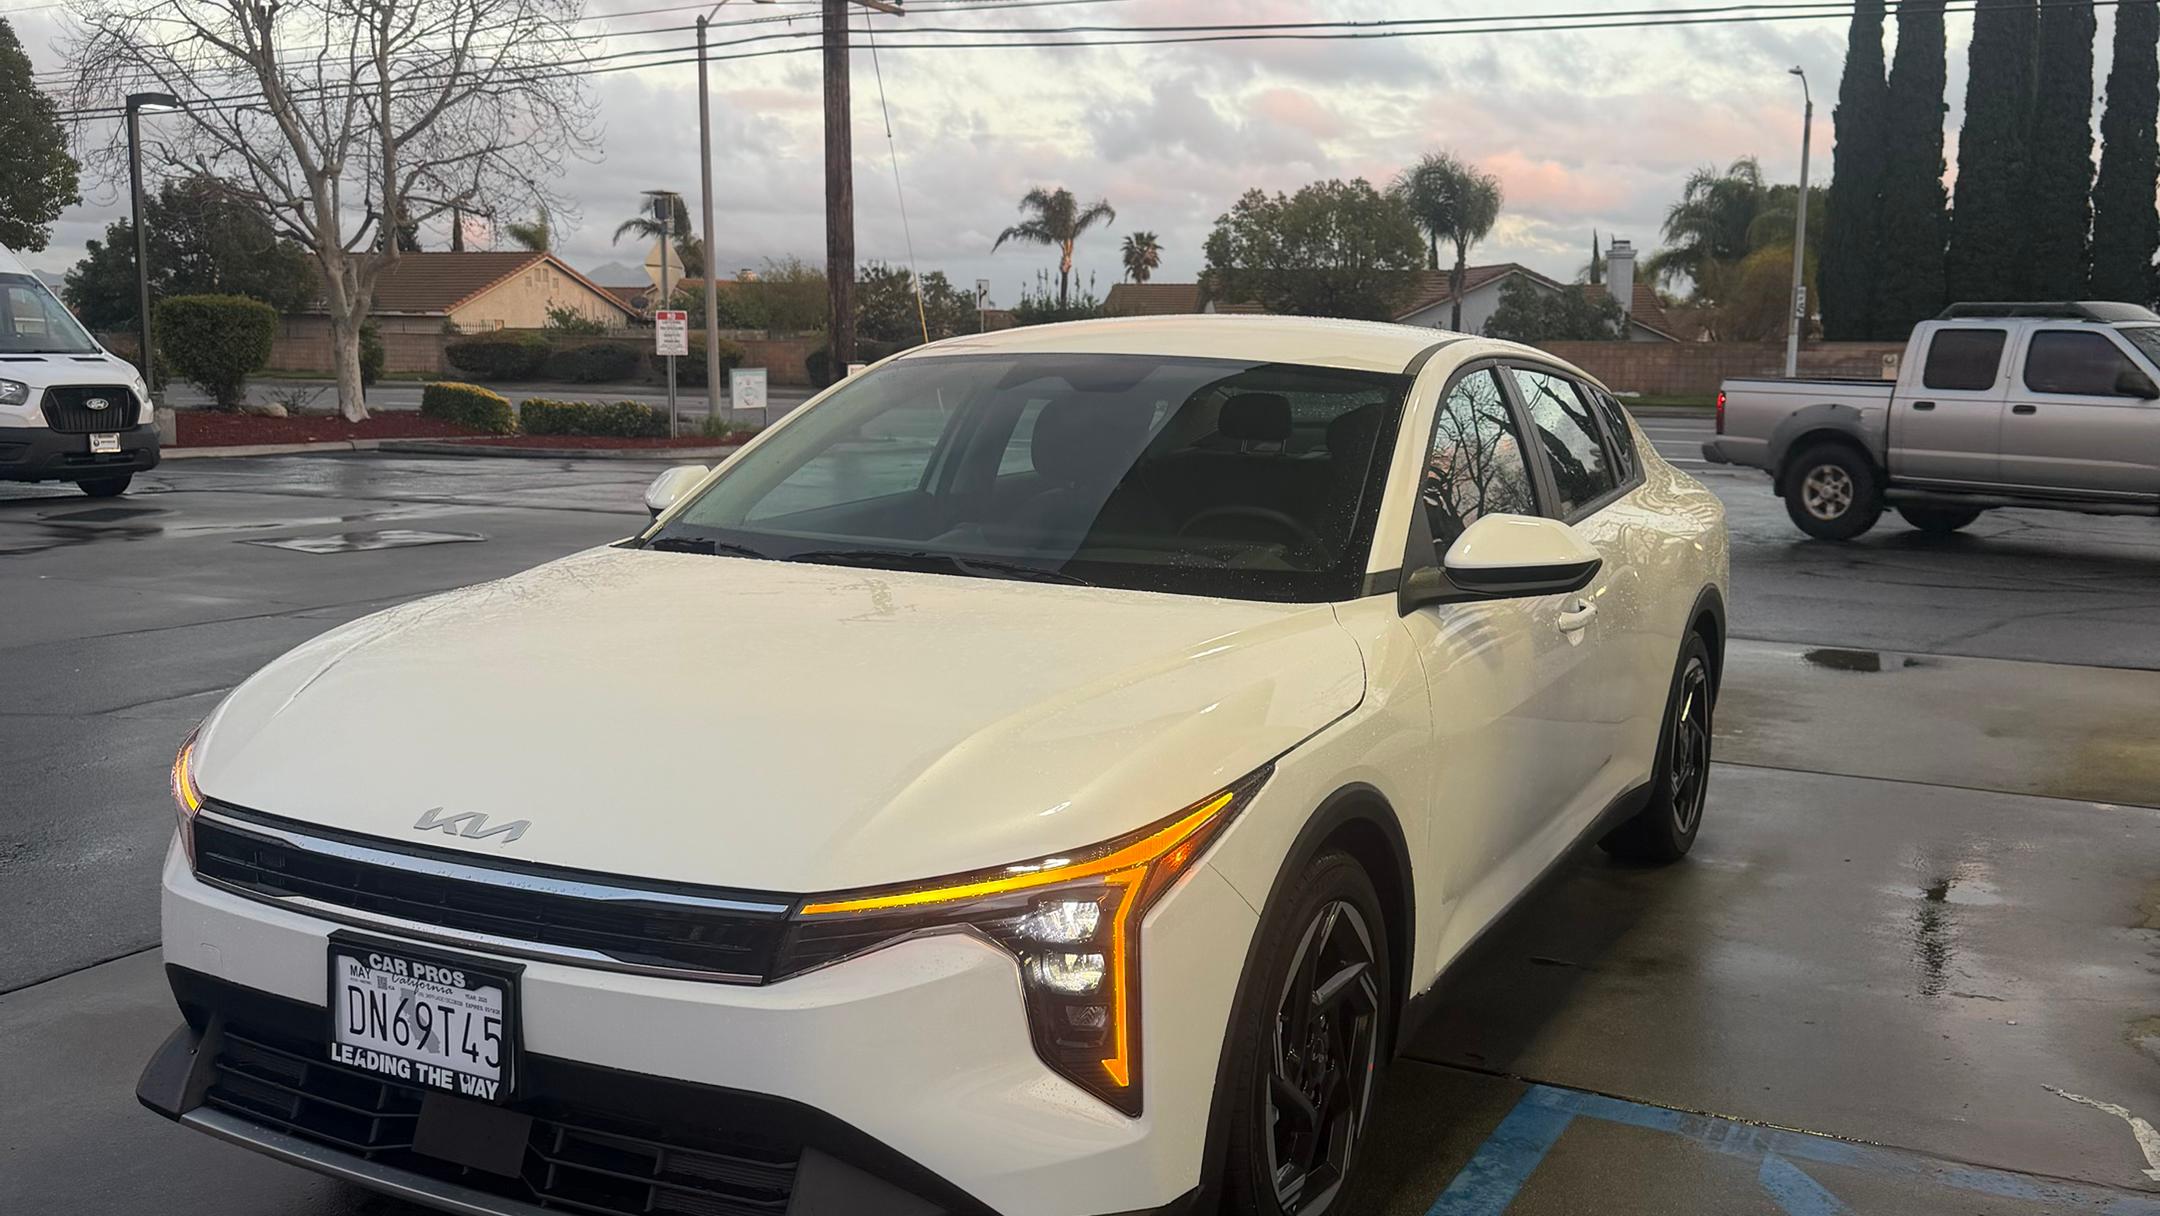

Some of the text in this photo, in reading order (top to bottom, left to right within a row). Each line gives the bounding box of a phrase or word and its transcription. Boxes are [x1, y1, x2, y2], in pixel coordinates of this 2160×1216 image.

[350, 964, 372, 980] MAY
[369, 953, 466, 988] CAR PROS
[392, 972, 453, 995] California
[347, 985, 502, 1069] DN69T45
[331, 1042, 499, 1101] LEADING THE WAY
